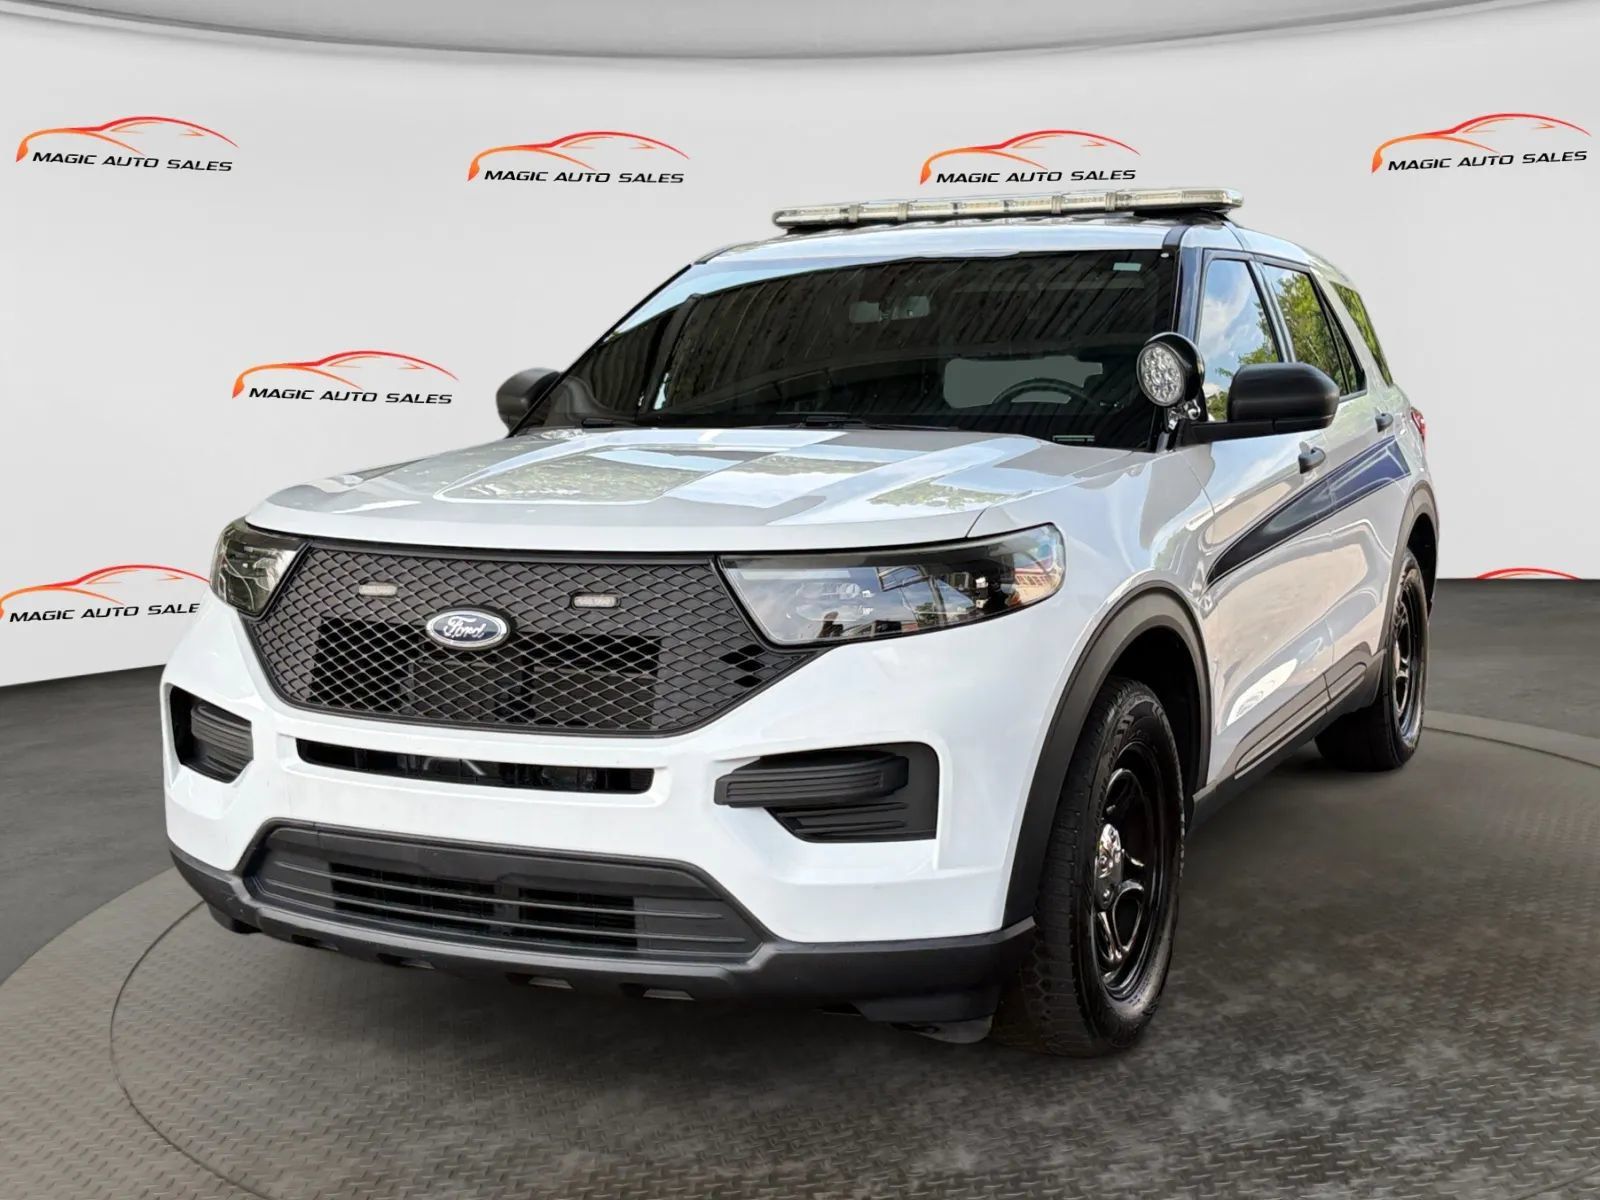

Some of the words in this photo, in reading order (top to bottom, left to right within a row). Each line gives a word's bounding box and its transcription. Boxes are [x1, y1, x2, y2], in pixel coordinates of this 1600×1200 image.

[33, 151, 97, 165] MAGIC
[102, 156, 160, 170] AUTO
[167, 160, 233, 172] SALES
[1388, 156, 1452, 171] MAGIC
[1457, 154, 1514, 168] AUTO
[1522, 151, 1588, 164] SALES
[484, 170, 549, 182] MAGIC
[553, 171, 611, 183] AUTO
[618, 172, 685, 184] SALES
[936, 172, 1001, 184] MAGIC
[1006, 171, 1063, 183] AUTO
[1070, 169, 1136, 182] SALES
[248, 387, 315, 401] MAGIC
[320, 390, 378, 403] AUTO
[385, 391, 453, 405] SALES
[9, 609, 76, 623] MAGIC
[81, 606, 140, 619] AUTO
[148, 603, 201, 616] SALE
[443, 616, 486, 638] Ford
